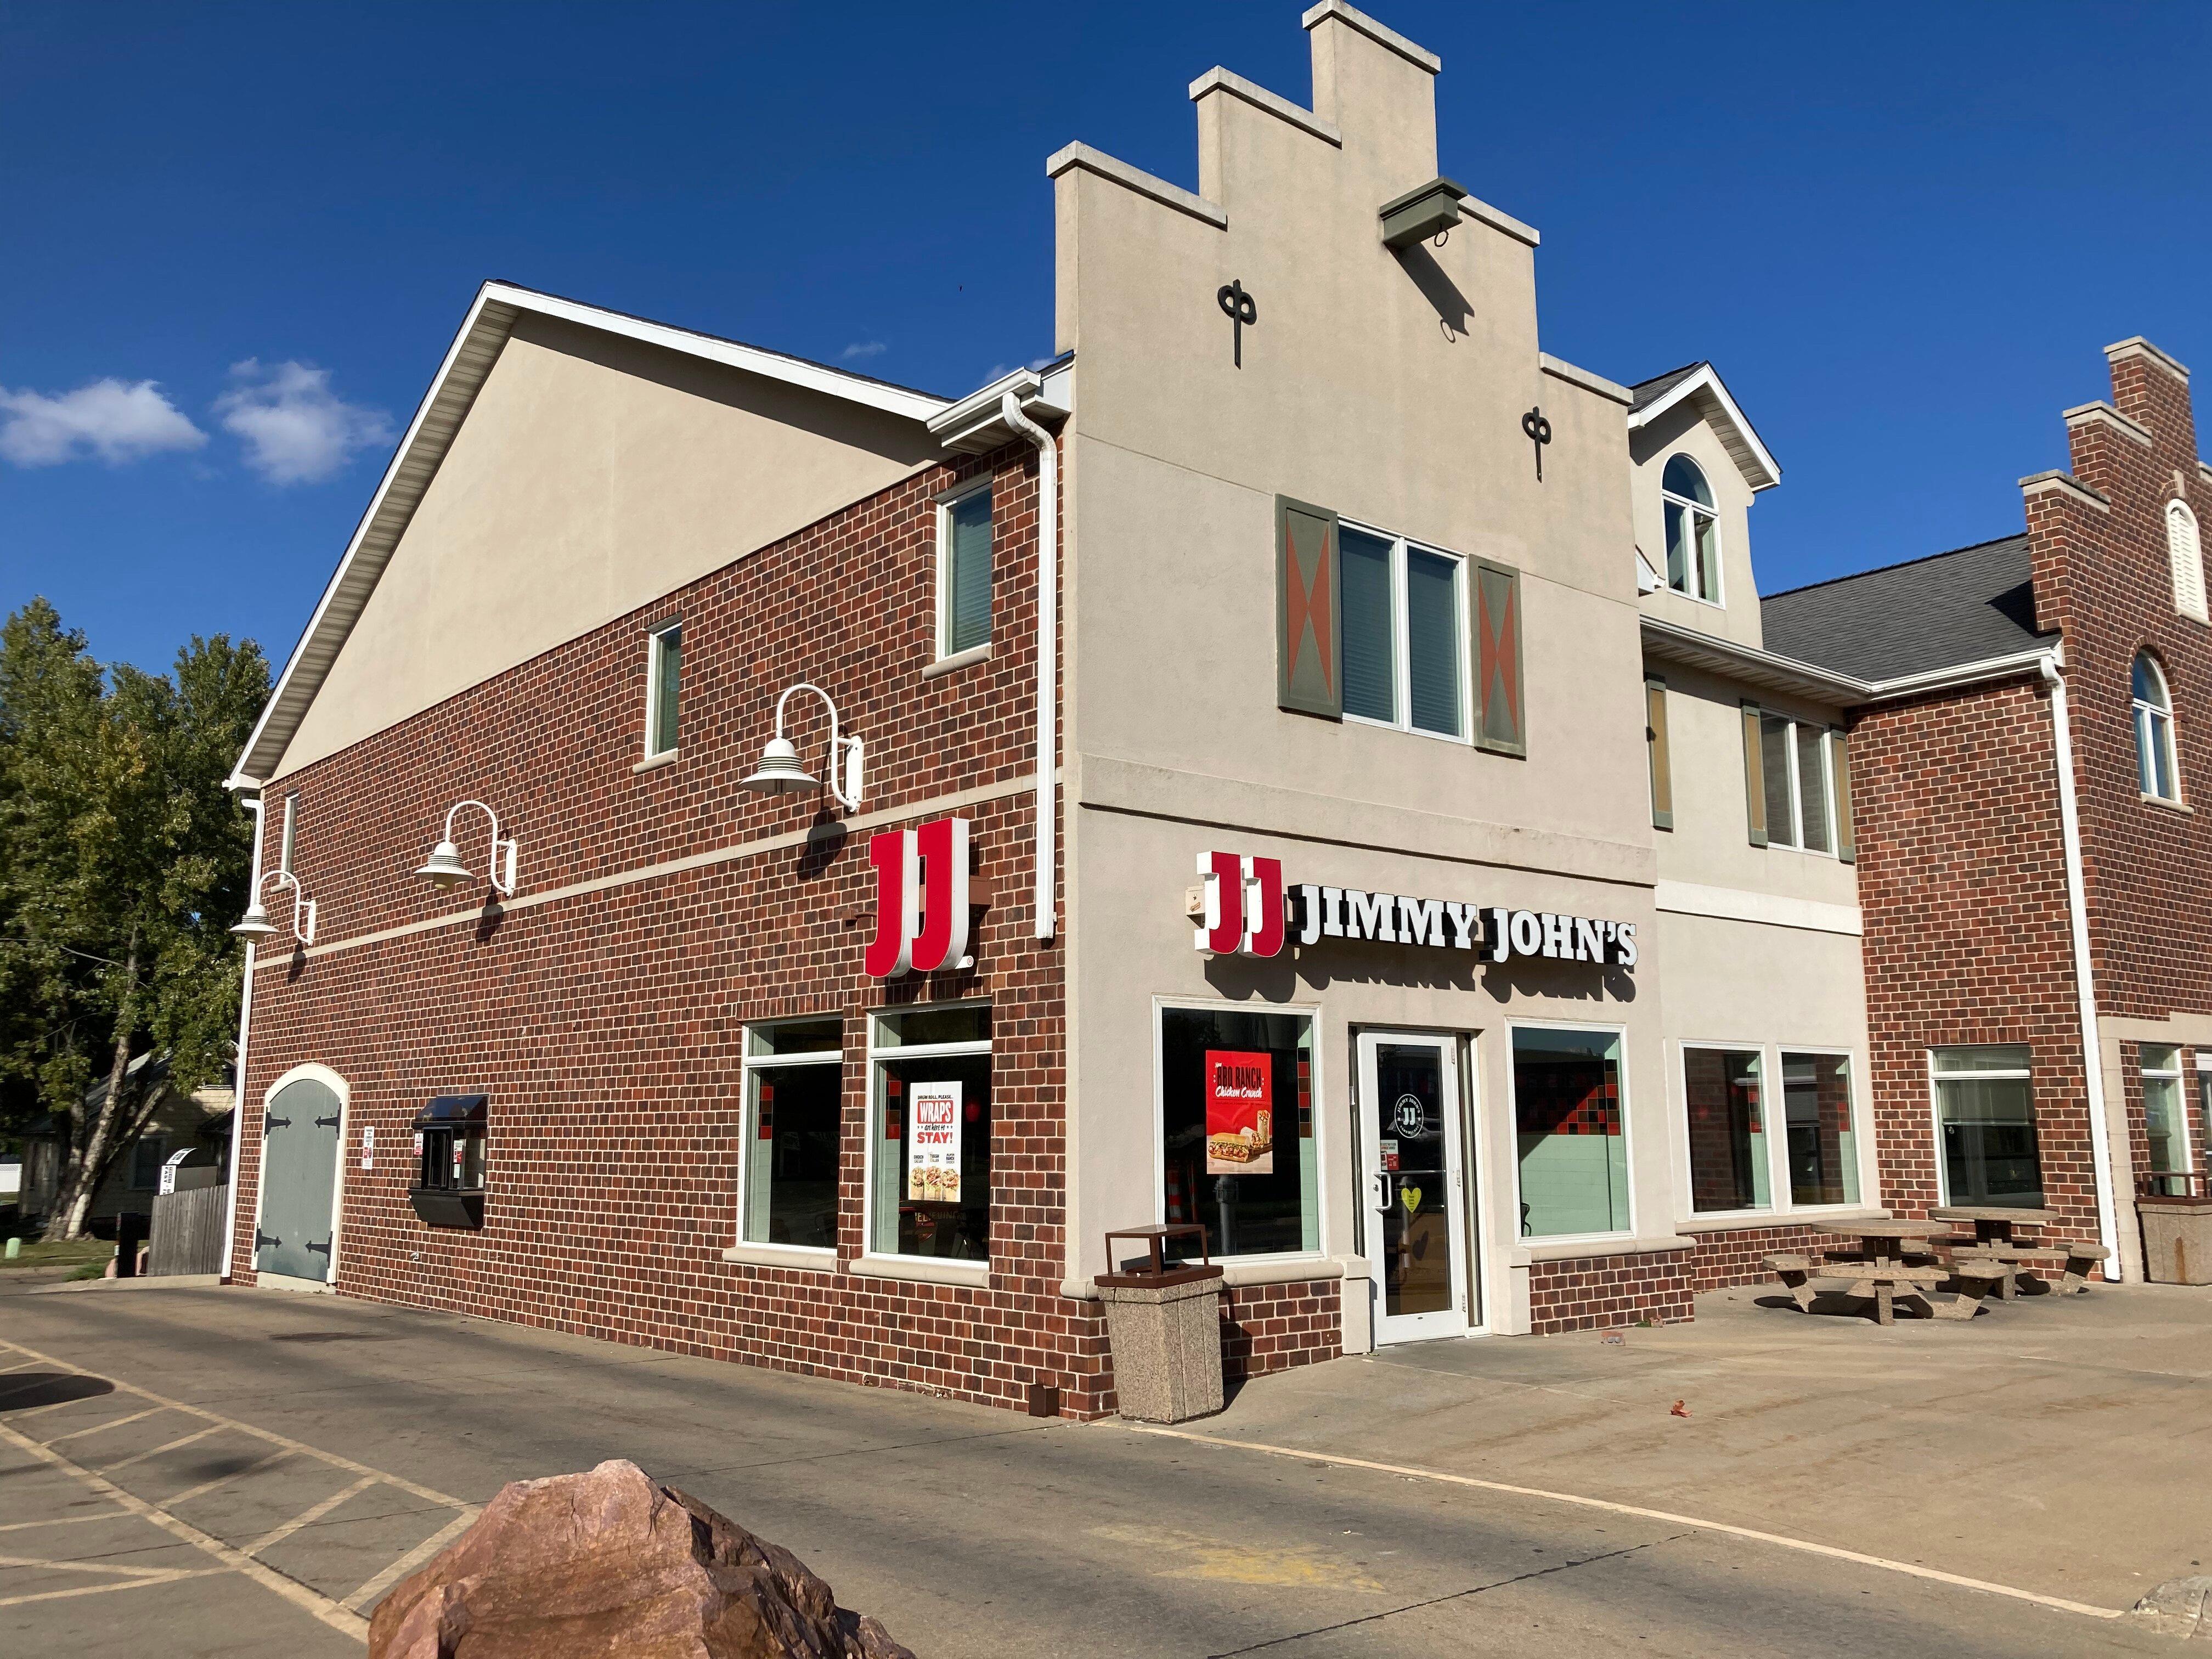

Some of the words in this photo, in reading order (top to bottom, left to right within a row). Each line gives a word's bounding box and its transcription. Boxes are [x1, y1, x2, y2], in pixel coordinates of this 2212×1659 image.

[865, 817, 955, 978] JJ
[1206, 851, 1284, 958] JJ
[1298, 885, 1477, 949] JIMMY
[1491, 908, 1638, 967] JOHN'S
[1235, 1066, 1261, 1089] RANCH
[1215, 1085, 1240, 1097] Chicken
[1241, 1086, 1262, 1098] Crunch
[919, 1102, 951, 1122] WRAPS
[1397, 1098, 1408, 1113] JIMMY
[1409, 1097, 1420, 1114] JOHN'S
[1403, 1107, 1415, 1126] JJ
[917, 1132, 953, 1143] STAY!
